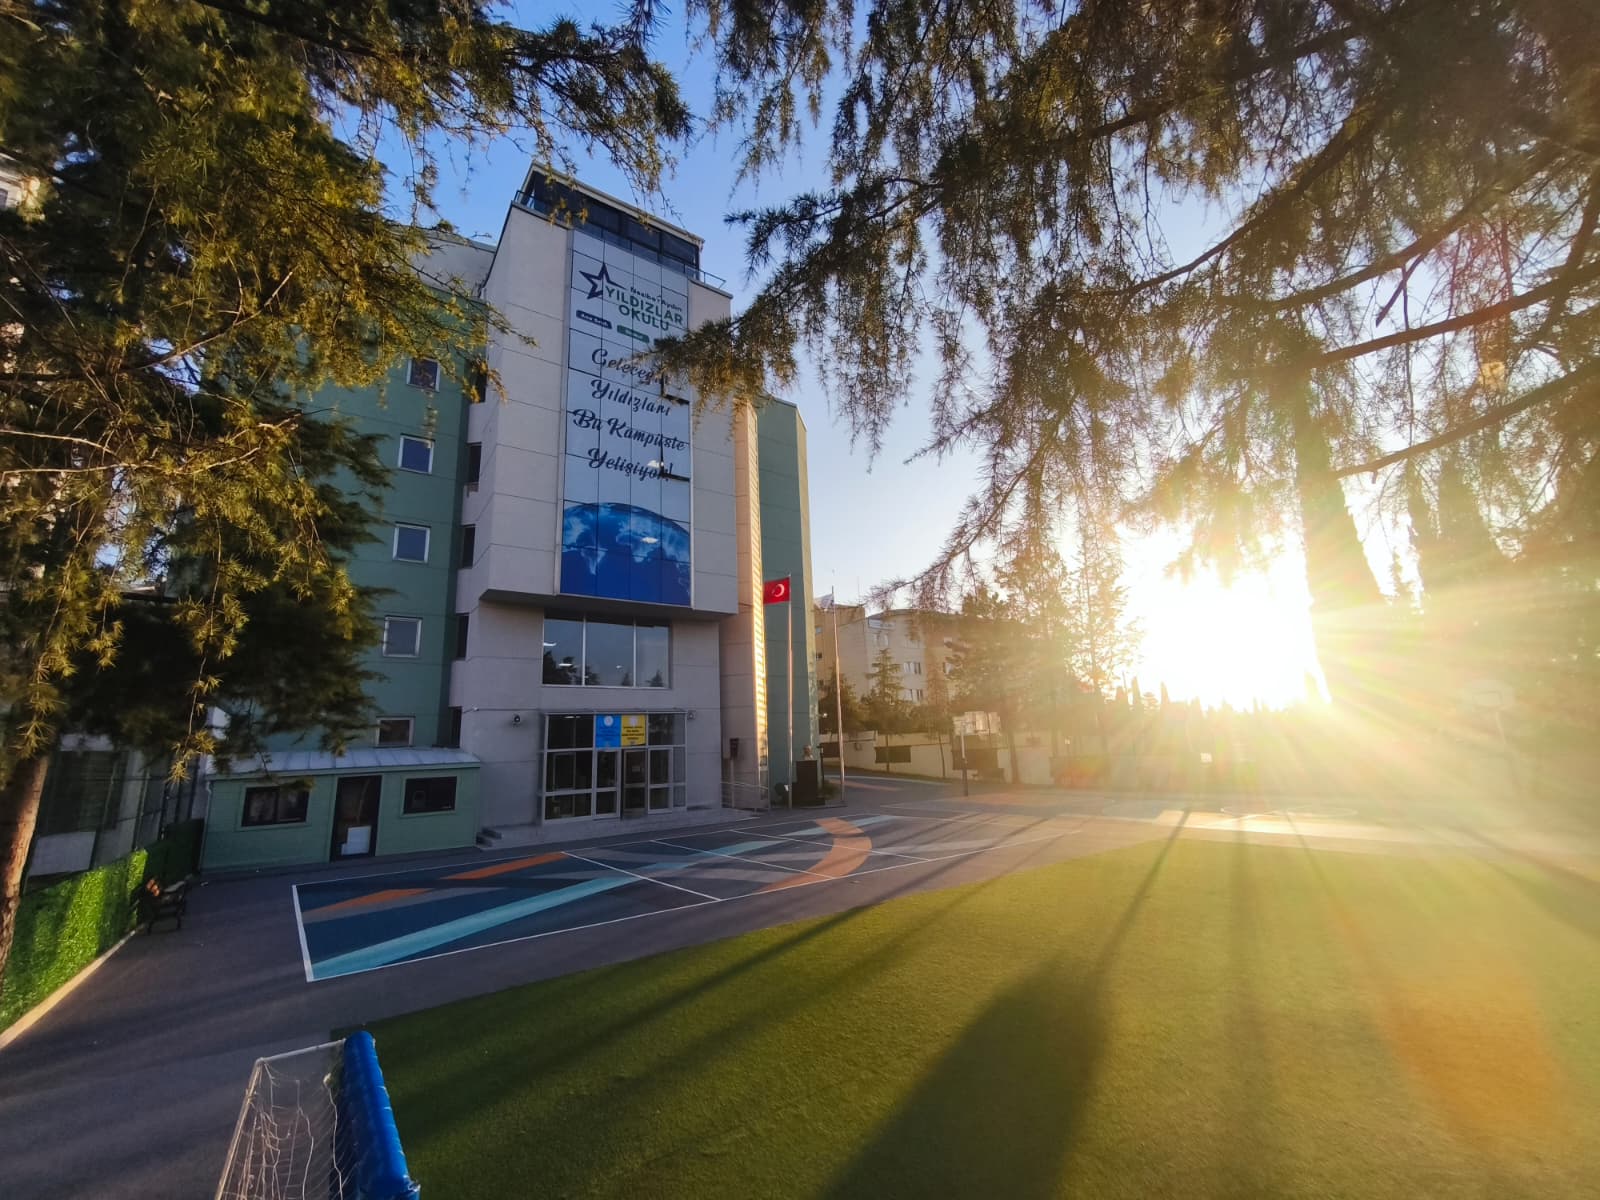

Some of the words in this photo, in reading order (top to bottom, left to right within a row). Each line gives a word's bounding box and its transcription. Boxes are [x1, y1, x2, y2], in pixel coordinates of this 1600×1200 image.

[605, 285, 683, 326] YILDIZLAR
[618, 304, 669, 331] OKULU
[590, 379, 671, 417] Yıldızları
[572, 408, 603, 431] Bu
[607, 417, 685, 451] Kampüste
